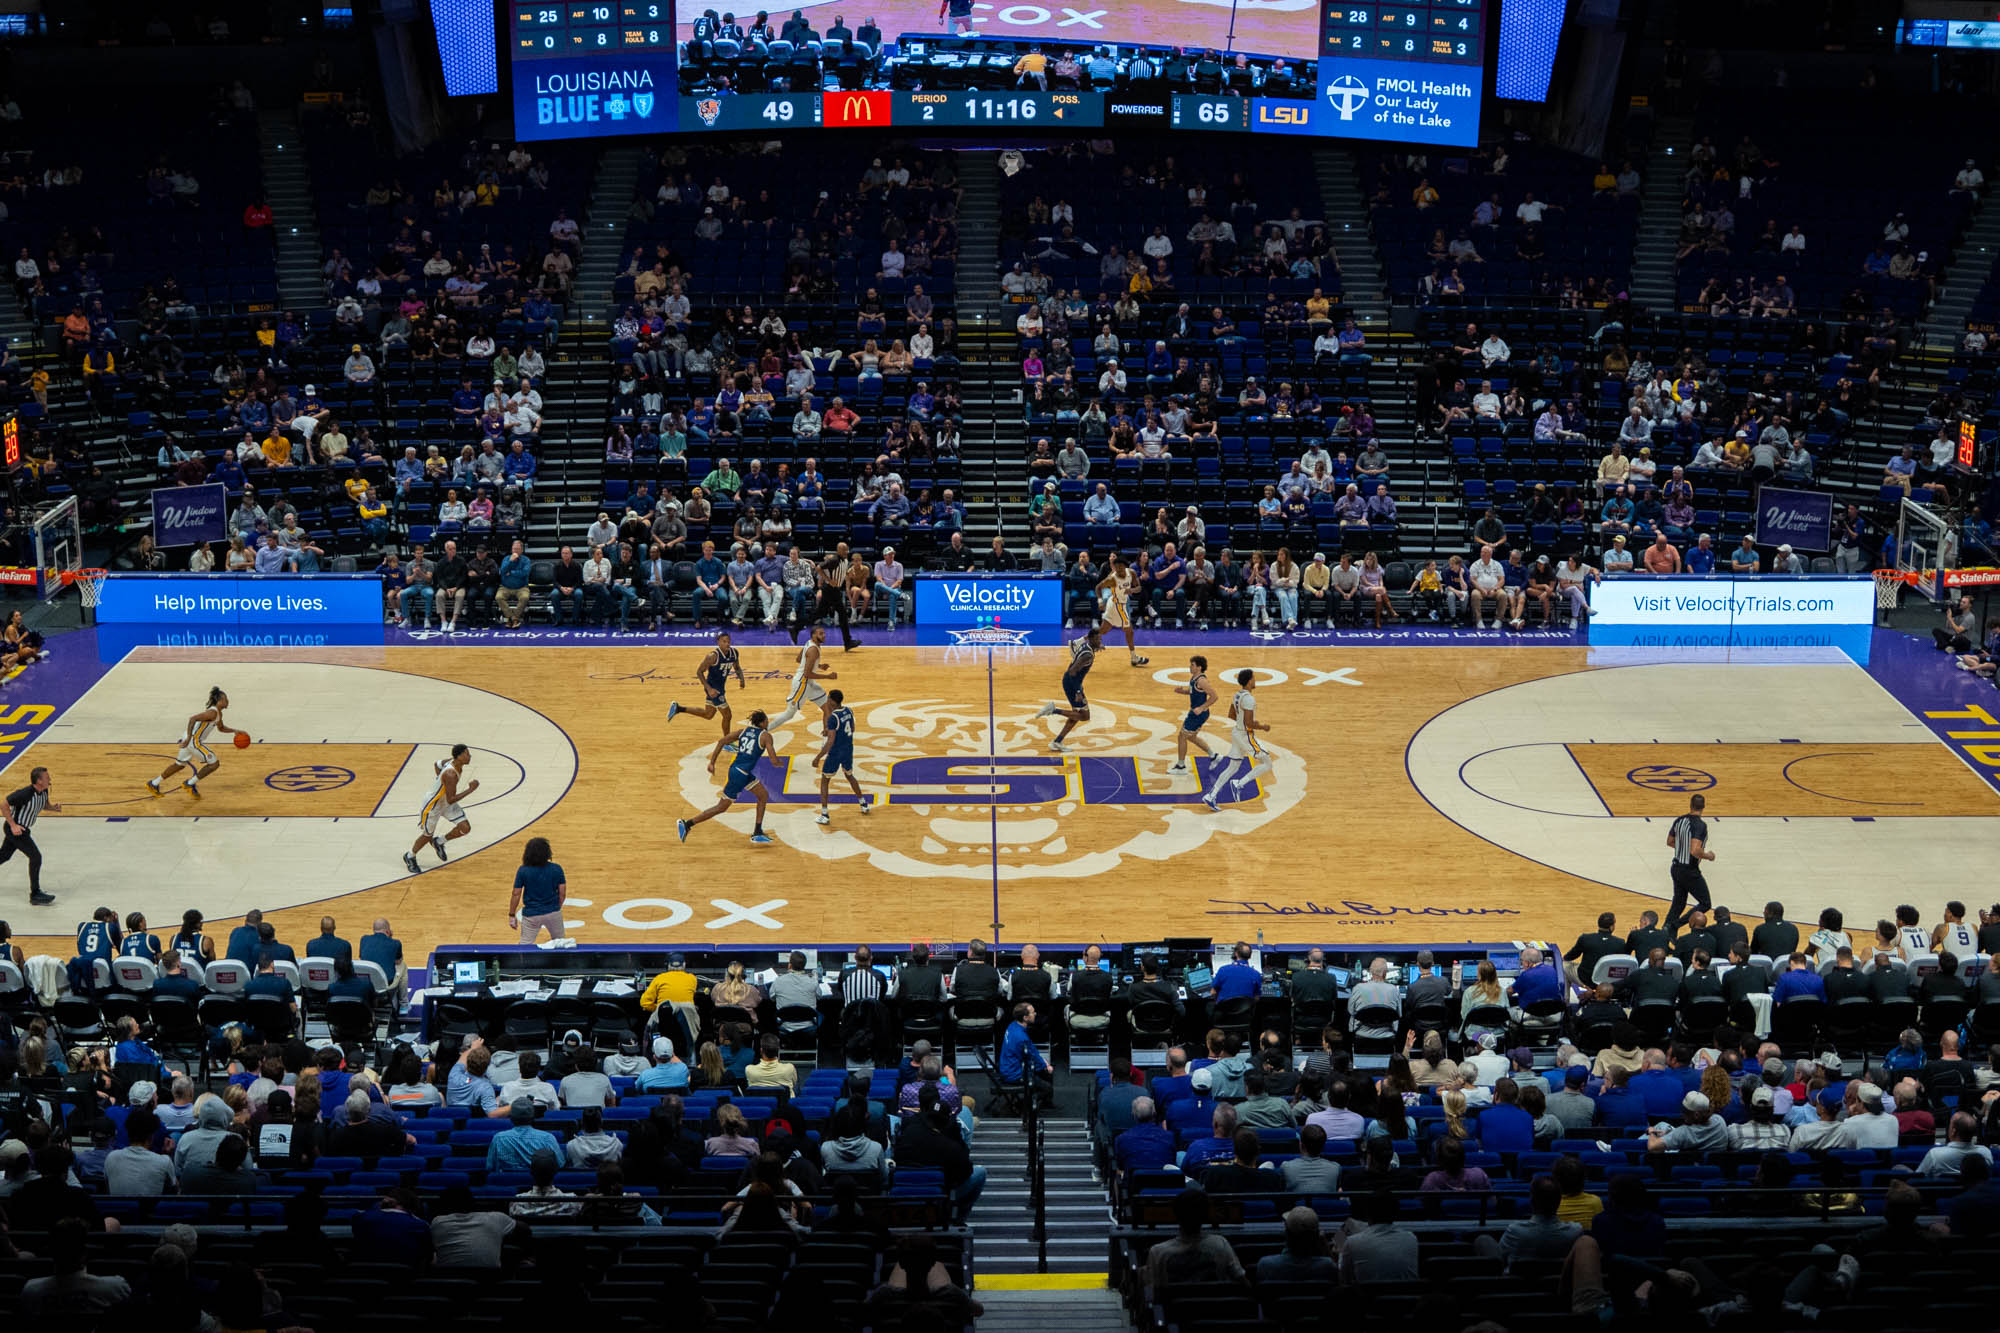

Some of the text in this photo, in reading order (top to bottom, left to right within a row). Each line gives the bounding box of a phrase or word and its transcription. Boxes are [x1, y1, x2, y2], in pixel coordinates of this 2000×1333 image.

[539, 11, 557, 23] 25
[592, 8, 609, 20] 10
[648, 6, 658, 17] 3
[1350, 11, 1367, 23] 28
[1406, 14, 1416, 26] 9
[1458, 18, 1468, 30] 4
[544, 36, 554, 48] 0
[597, 34, 607, 45] 8
[649, 31, 658, 42] 8
[1352, 36, 1362, 48] 2
[1405, 39, 1414, 51] 8
[1457, 43, 1466, 55] 3
[536, 70, 654, 94] LOUISIANA
[1376, 78, 1471, 97] FMOL Health
[912, 94, 947, 103] PERIOD
[1052, 95, 1080, 104] POSS.
[1375, 95, 1438, 113] Our Lady
[538, 94, 600, 125] BLUE
[763, 101, 794, 121] 49
[923, 105, 934, 120] 2
[965, 99, 1036, 119] 11:16
[1111, 104, 1164, 115] POWERADE
[1198, 103, 1229, 123] 65
[1260, 106, 1308, 125] LSU
[1374, 111, 1451, 127] of the Lake
[5, 434, 19, 464] 28
[1959, 436, 1974, 465] 28
[162, 505, 216, 529] Window
[943, 583, 1035, 608] Velocity
[155, 594, 328, 614] Help Improve Lives.
[1633, 596, 1834, 615] Visit VelocityTrials.com
[493, 631, 544, 639] Lady
[1336, 631, 1384, 639] Lady
[844, 721, 852, 736] 4
[740, 737, 756, 755] 34
[723, 754, 1265, 806] LSU
[86, 934, 99, 952] 9
[1911, 934, 1925, 948] 11
[1958, 932, 1970, 945] 9
